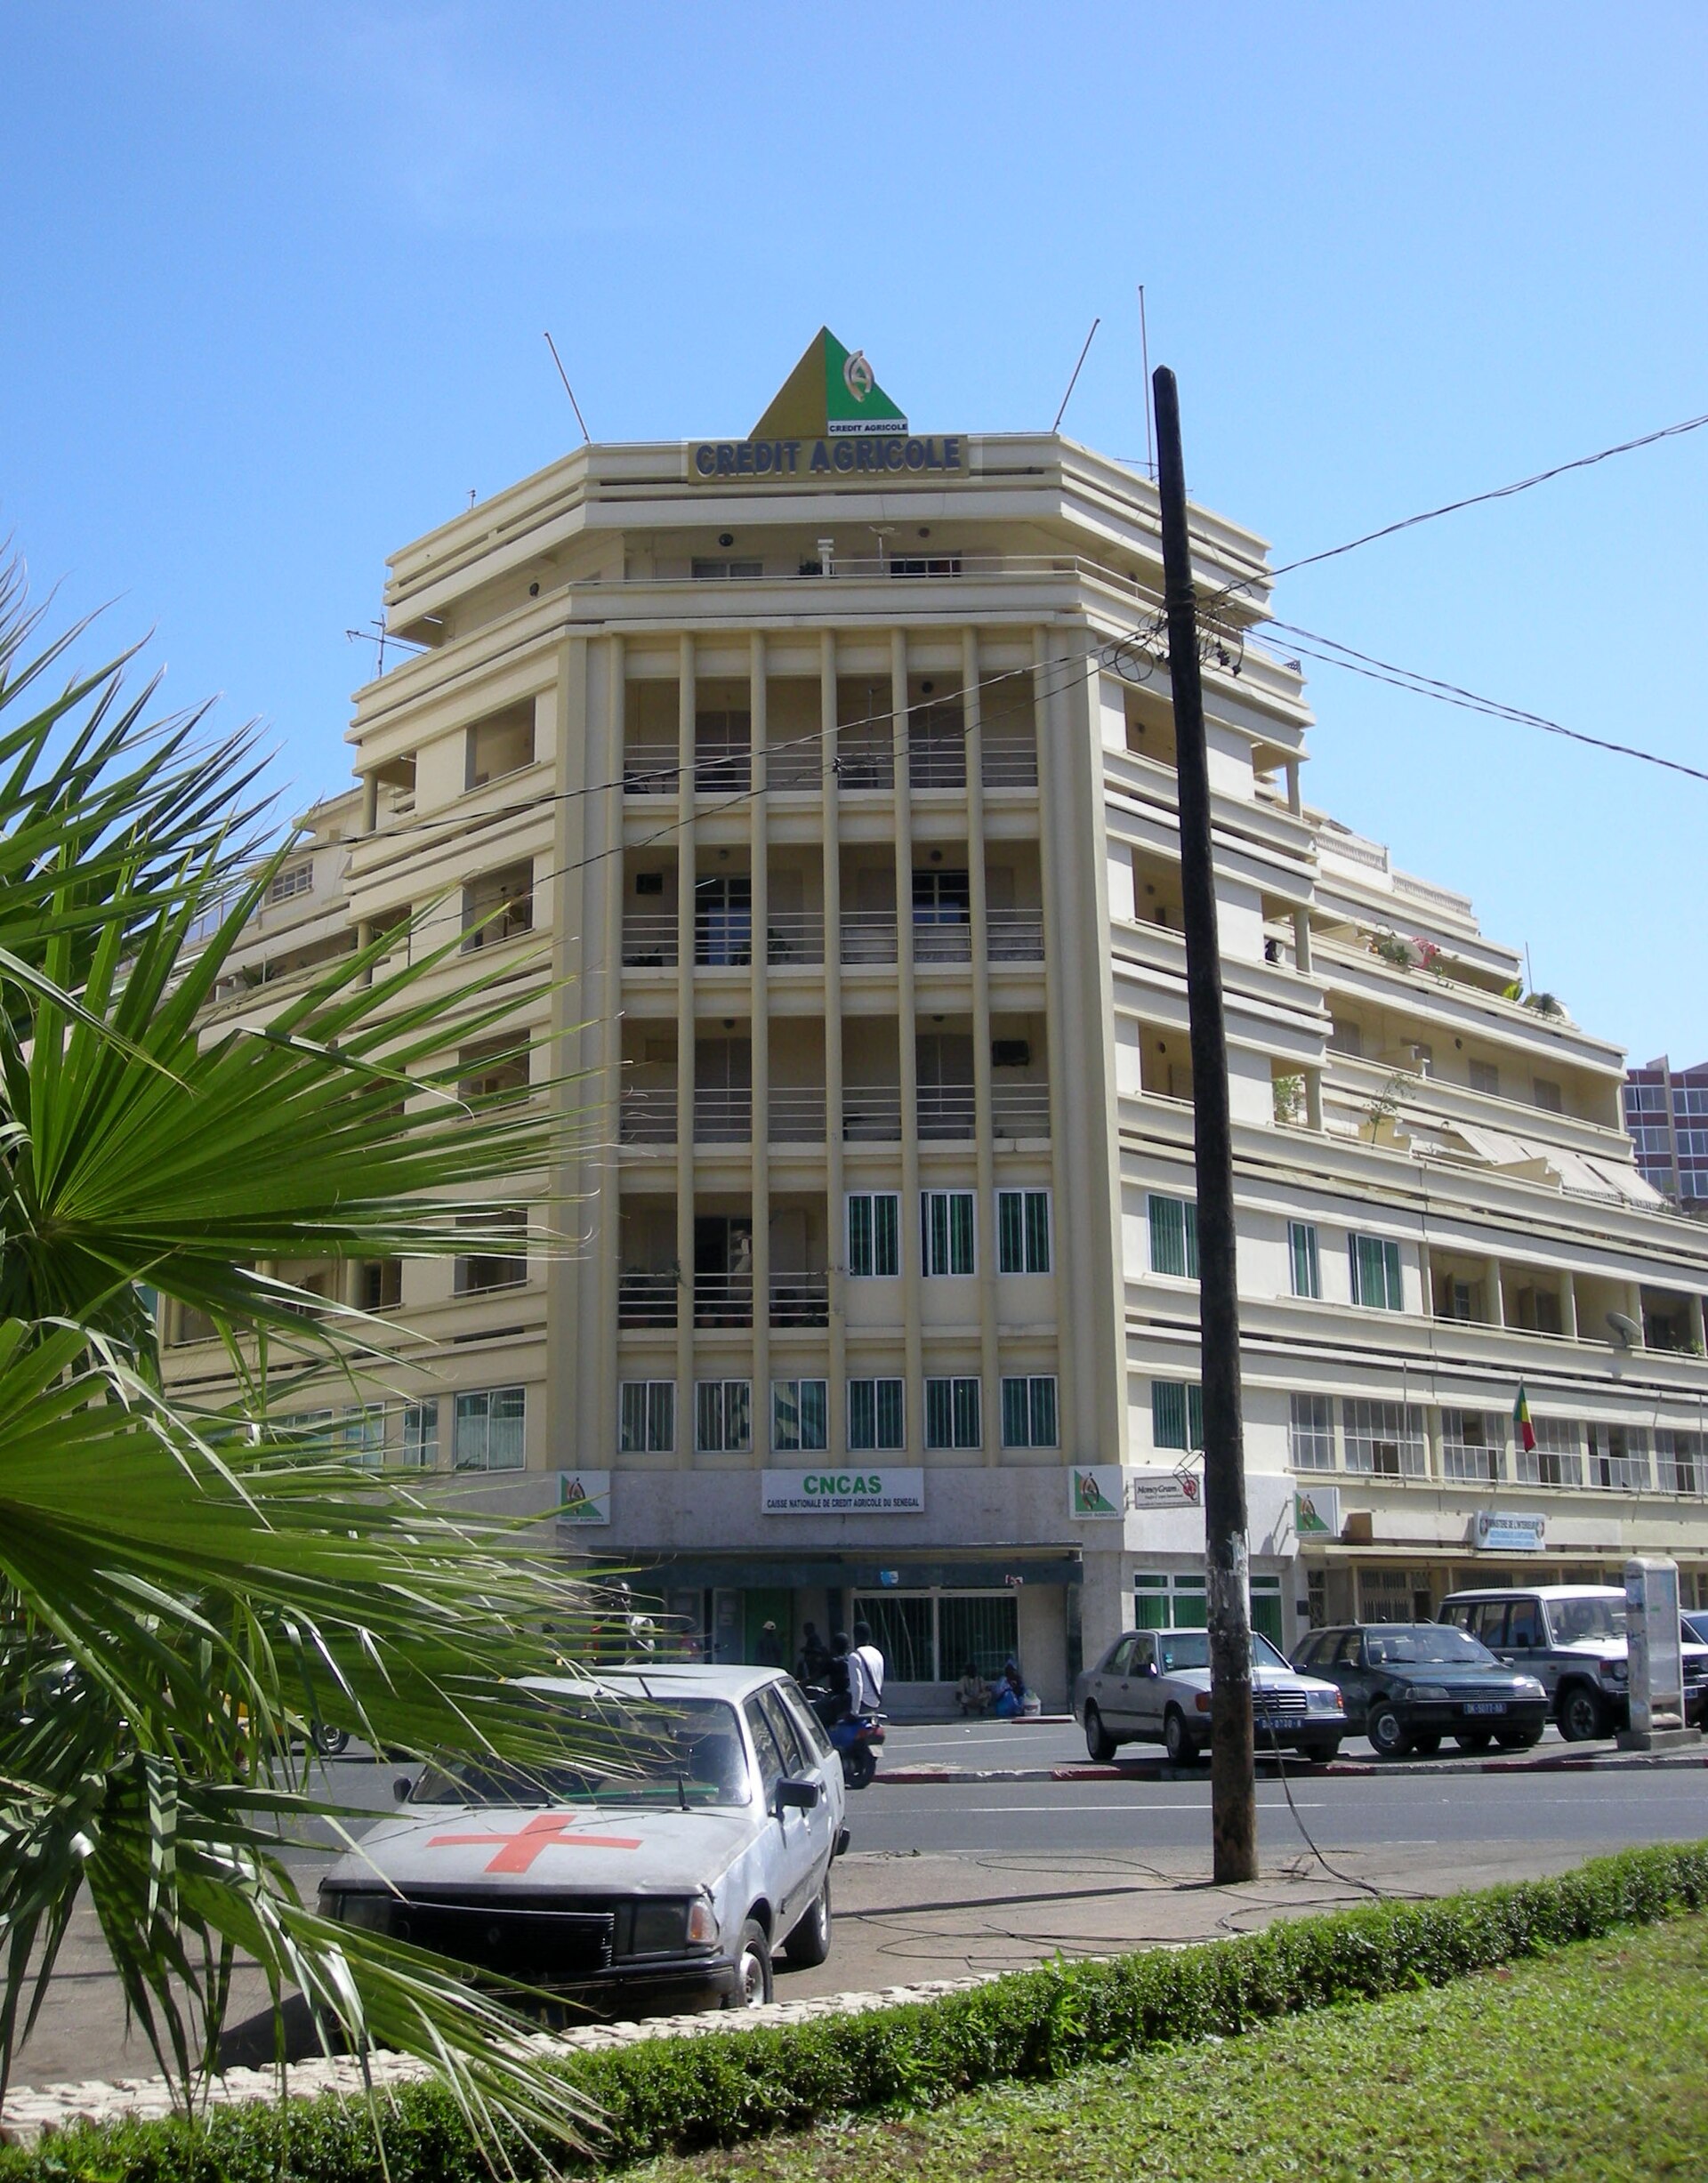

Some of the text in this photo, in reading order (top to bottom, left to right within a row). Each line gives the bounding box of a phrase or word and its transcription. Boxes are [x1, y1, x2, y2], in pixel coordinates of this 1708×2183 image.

[829, 423, 907, 432] CREDIT AGRICOLE
[696, 439, 961, 478] CREDIT AGRICOLE
[803, 1475, 882, 1494] CNCAS
[1138, 1485, 1177, 1494] MoneyGram
[767, 1497, 919, 1508] CAISSE NATIONALE DE CREDIT AGRICOLE DU SENEGAL
